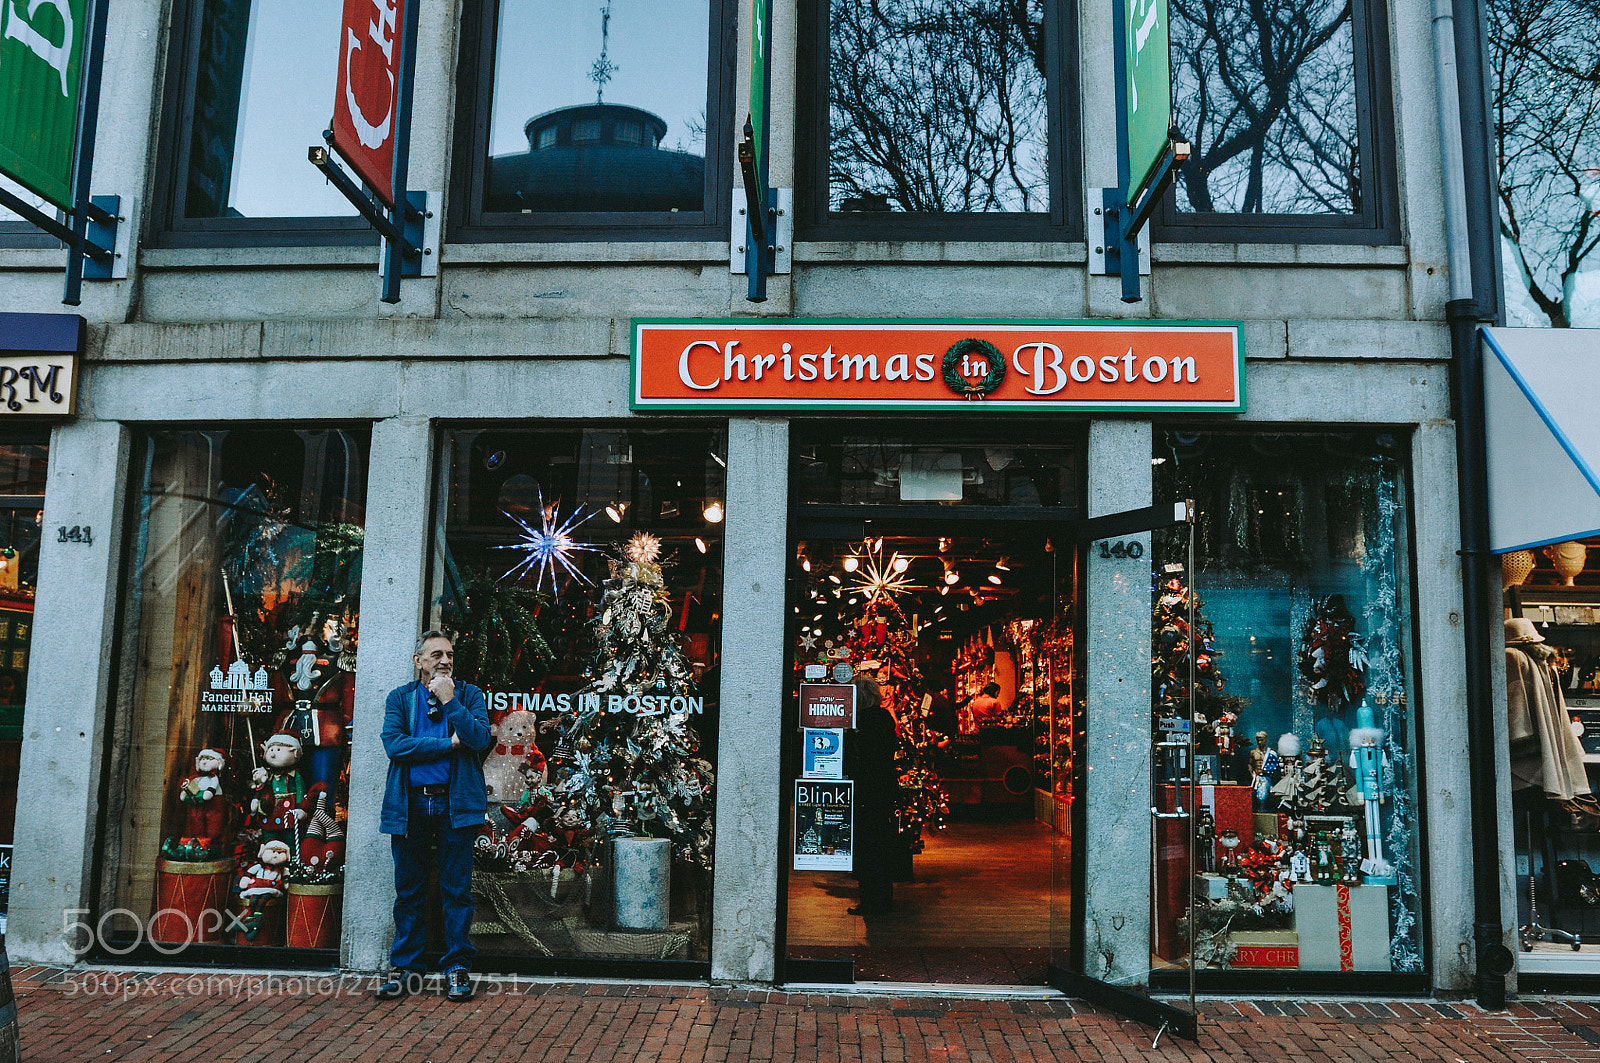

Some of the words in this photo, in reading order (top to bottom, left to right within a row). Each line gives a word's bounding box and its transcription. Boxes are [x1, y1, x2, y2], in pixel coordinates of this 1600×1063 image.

[678, 340, 935, 391] Christmas
[963, 354, 990, 378] in
[1012, 341, 1200, 395] Boston
[57, 525, 92, 543] 141
[1100, 540, 1144, 559] 140
[202, 691, 246, 703] Faneuil
[249, 692, 273, 704] Hall
[578, 694, 601, 713] IN
[608, 695, 704, 715] BOSTON
[201, 704, 273, 713] MARKETPLACE
[808, 703, 845, 717] HIRING
[1160, 721, 1175, 729] Push
[798, 785, 850, 804] Blink!
